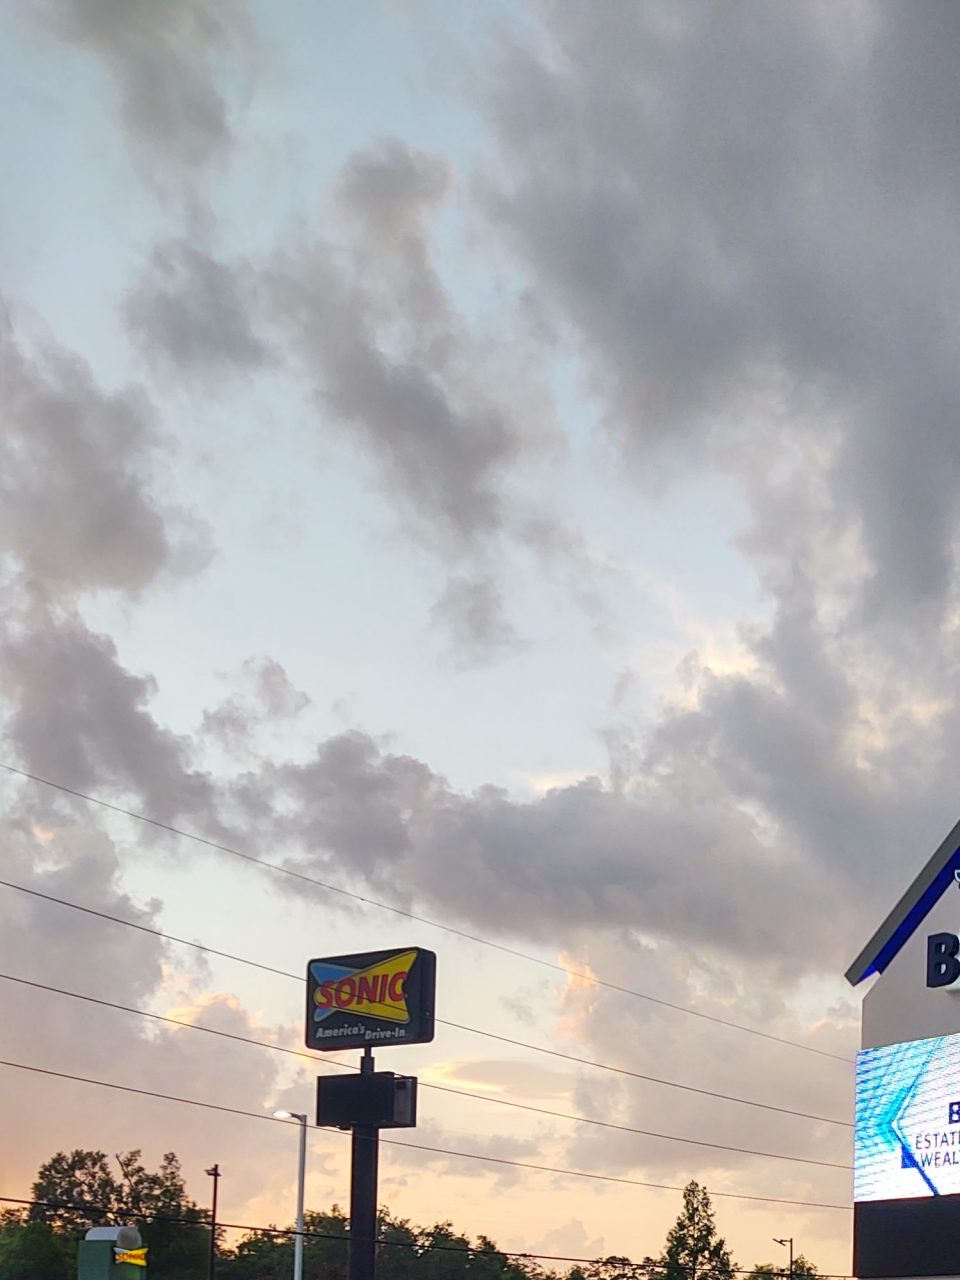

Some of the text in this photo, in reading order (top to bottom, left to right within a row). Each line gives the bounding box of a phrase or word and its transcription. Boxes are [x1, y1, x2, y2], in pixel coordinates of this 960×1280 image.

[315, 971, 408, 1009] SONIC
[316, 1023, 406, 1040] America's Drive-In
